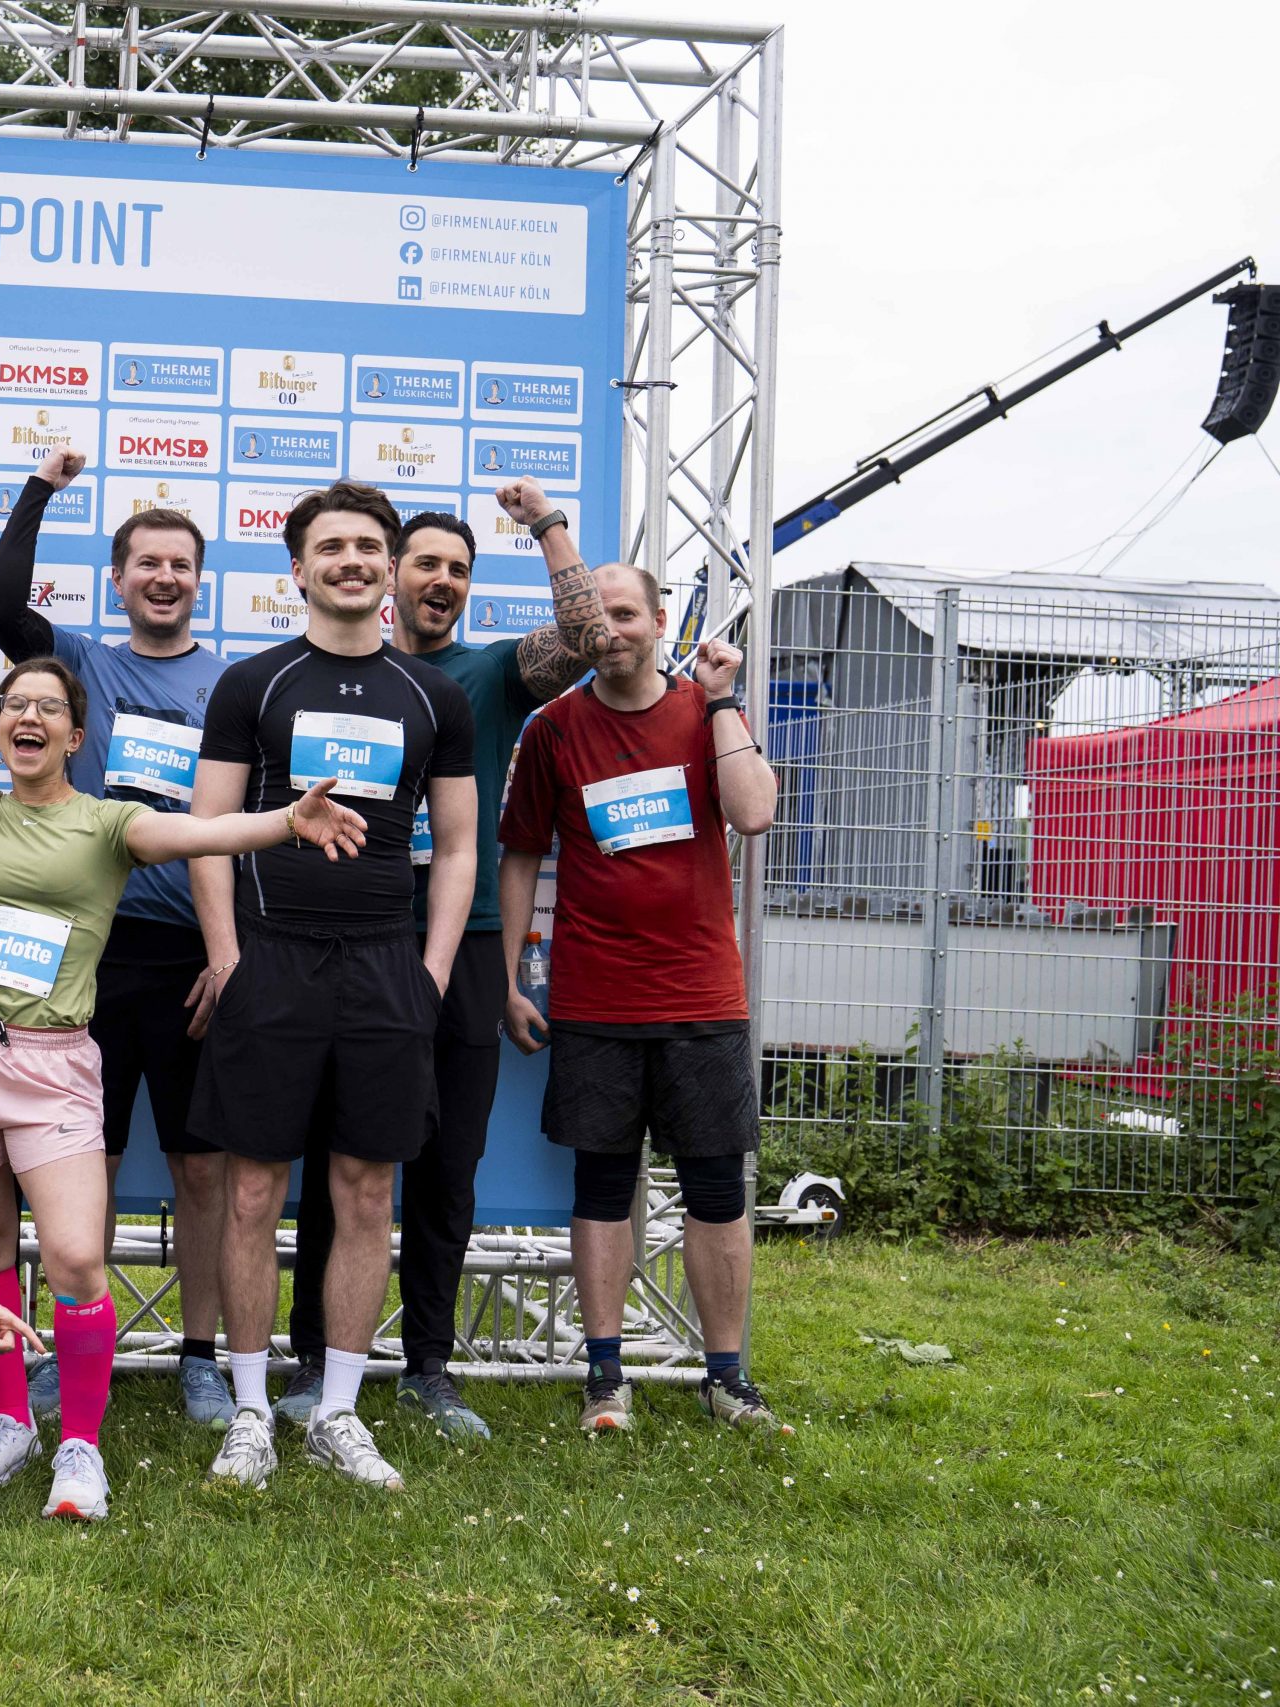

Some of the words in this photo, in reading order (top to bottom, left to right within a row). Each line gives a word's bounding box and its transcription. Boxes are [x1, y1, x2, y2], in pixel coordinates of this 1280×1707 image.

[432, 214, 558, 233] @FIRMENLAUF.KOELN
[431, 247, 517, 265] @FIRMENLAUF
[521, 250, 551, 267] KÖLN
[429, 281, 516, 299] @FIRMENLAUF
[520, 284, 550, 300] KÖLN
[0, 364, 66, 386] DKMS
[151, 363, 210, 377] THERME
[150, 377, 210, 387] EUSKIRCHEN
[257, 371, 316, 394] Bitburger
[393, 375, 452, 388] THERME
[514, 380, 572, 394] THERME
[49, 388, 87, 396] BLUTKREBS
[393, 388, 452, 399] EUSKIRCHEN
[513, 393, 572, 404] EUSKIRCHEN
[277, 392, 296, 406] 0.0
[119, 436, 186, 458] DKMS
[270, 436, 329, 449] THERME
[270, 449, 329, 460] EUSKIRCHEN
[377, 444, 436, 466] Bitburger
[512, 447, 571, 460] THERME
[397, 465, 415, 478] 0.0
[512, 460, 571, 470] EUSKIRCHEN
[239, 508, 290, 529] DKM
[50, 592, 86, 602] SPORTS
[506, 604, 554, 617] THERM
[271, 616, 290, 629] 0.0
[122, 740, 191, 771] Sascha
[324, 741, 372, 765] Paul
[144, 767, 161, 778] 810
[337, 769, 355, 779] 814
[606, 797, 670, 823] Stefan
[633, 821, 649, 832] 811
